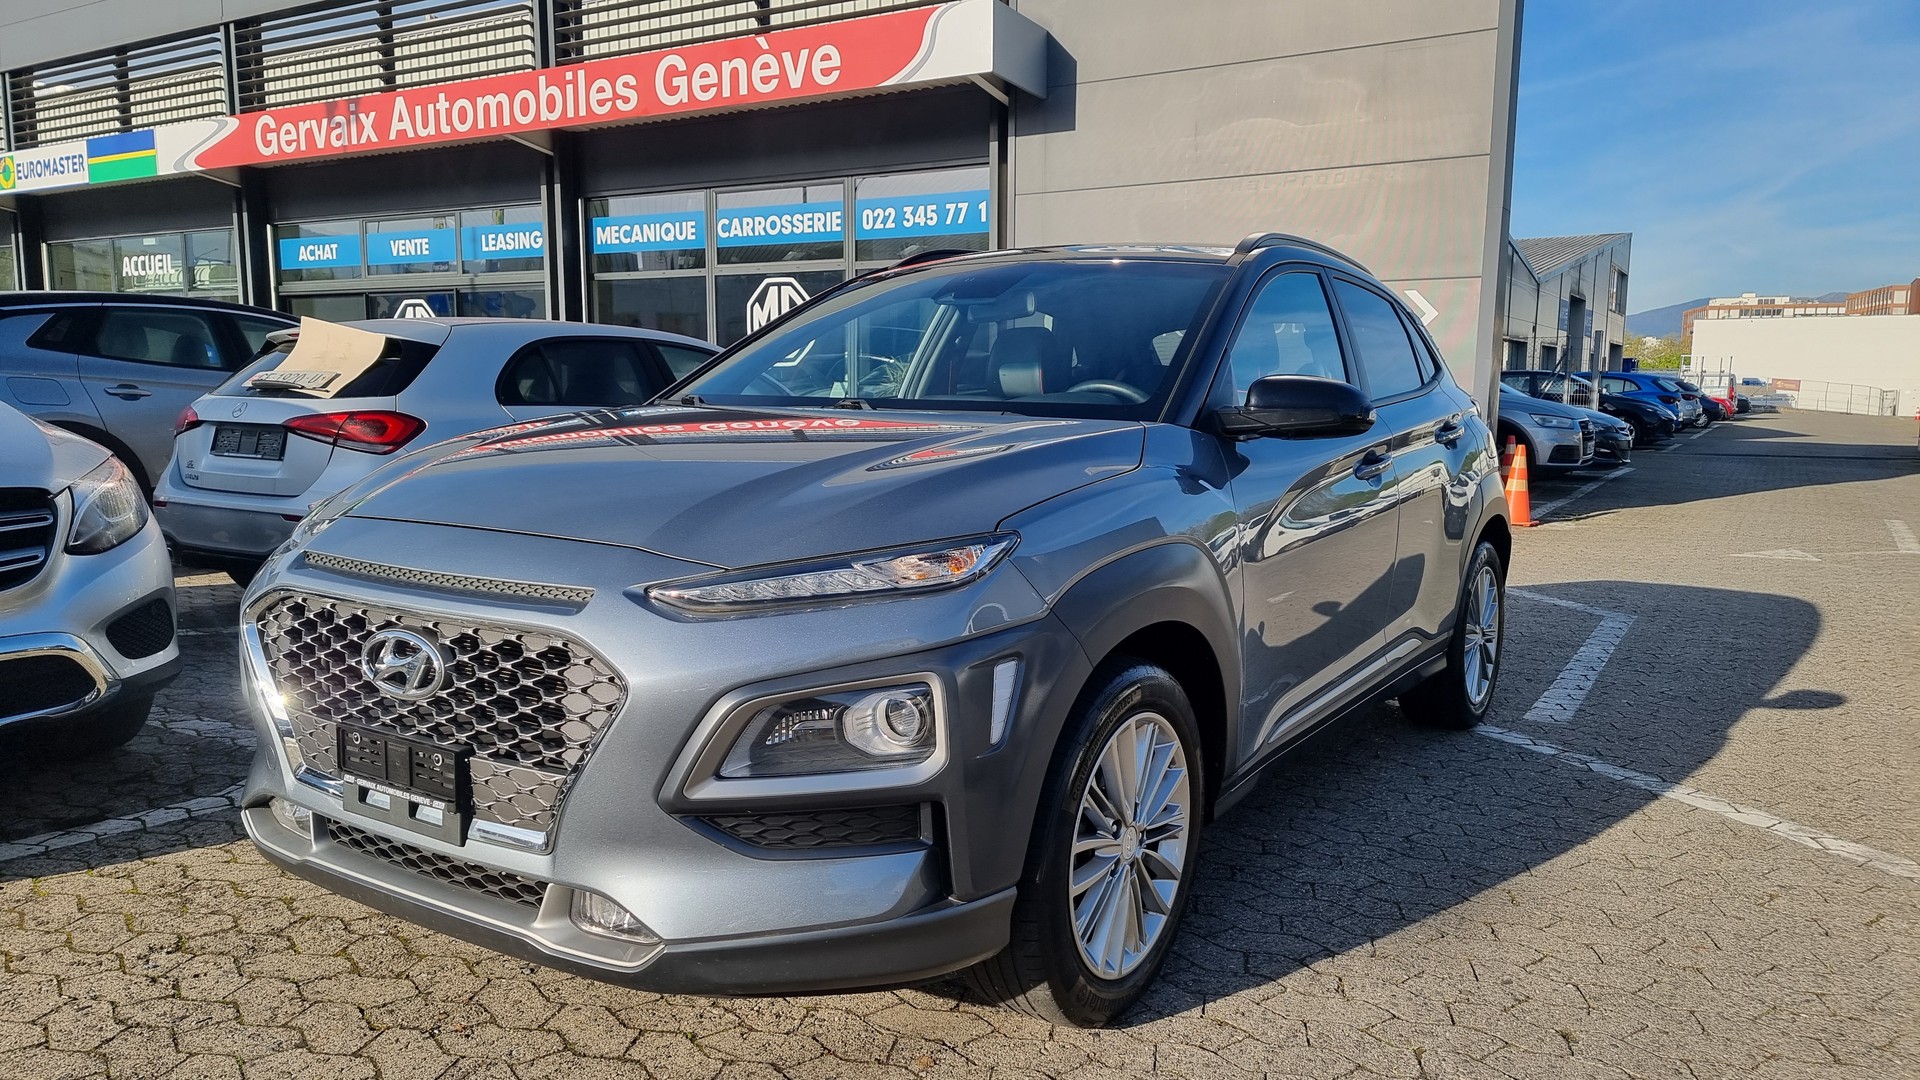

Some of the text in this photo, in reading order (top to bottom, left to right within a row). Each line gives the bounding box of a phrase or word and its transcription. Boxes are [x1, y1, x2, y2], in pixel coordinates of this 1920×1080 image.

[255, 36, 842, 156] Gervaix Automobiles Genève
[16, 154, 85, 180] EUROMASTER
[717, 211, 842, 238] CARROSSERIE
[862, 207, 896, 230] 022
[903, 204, 938, 227] 345
[945, 202, 969, 225] 77
[481, 231, 543, 252] LEASING
[596, 221, 696, 245] MECANIQUE
[298, 243, 338, 262] ACHAT
[390, 238, 430, 257] VENTE
[122, 253, 176, 277] ACCUEIL
[376, 784, 410, 800] AUTOMOBILES
